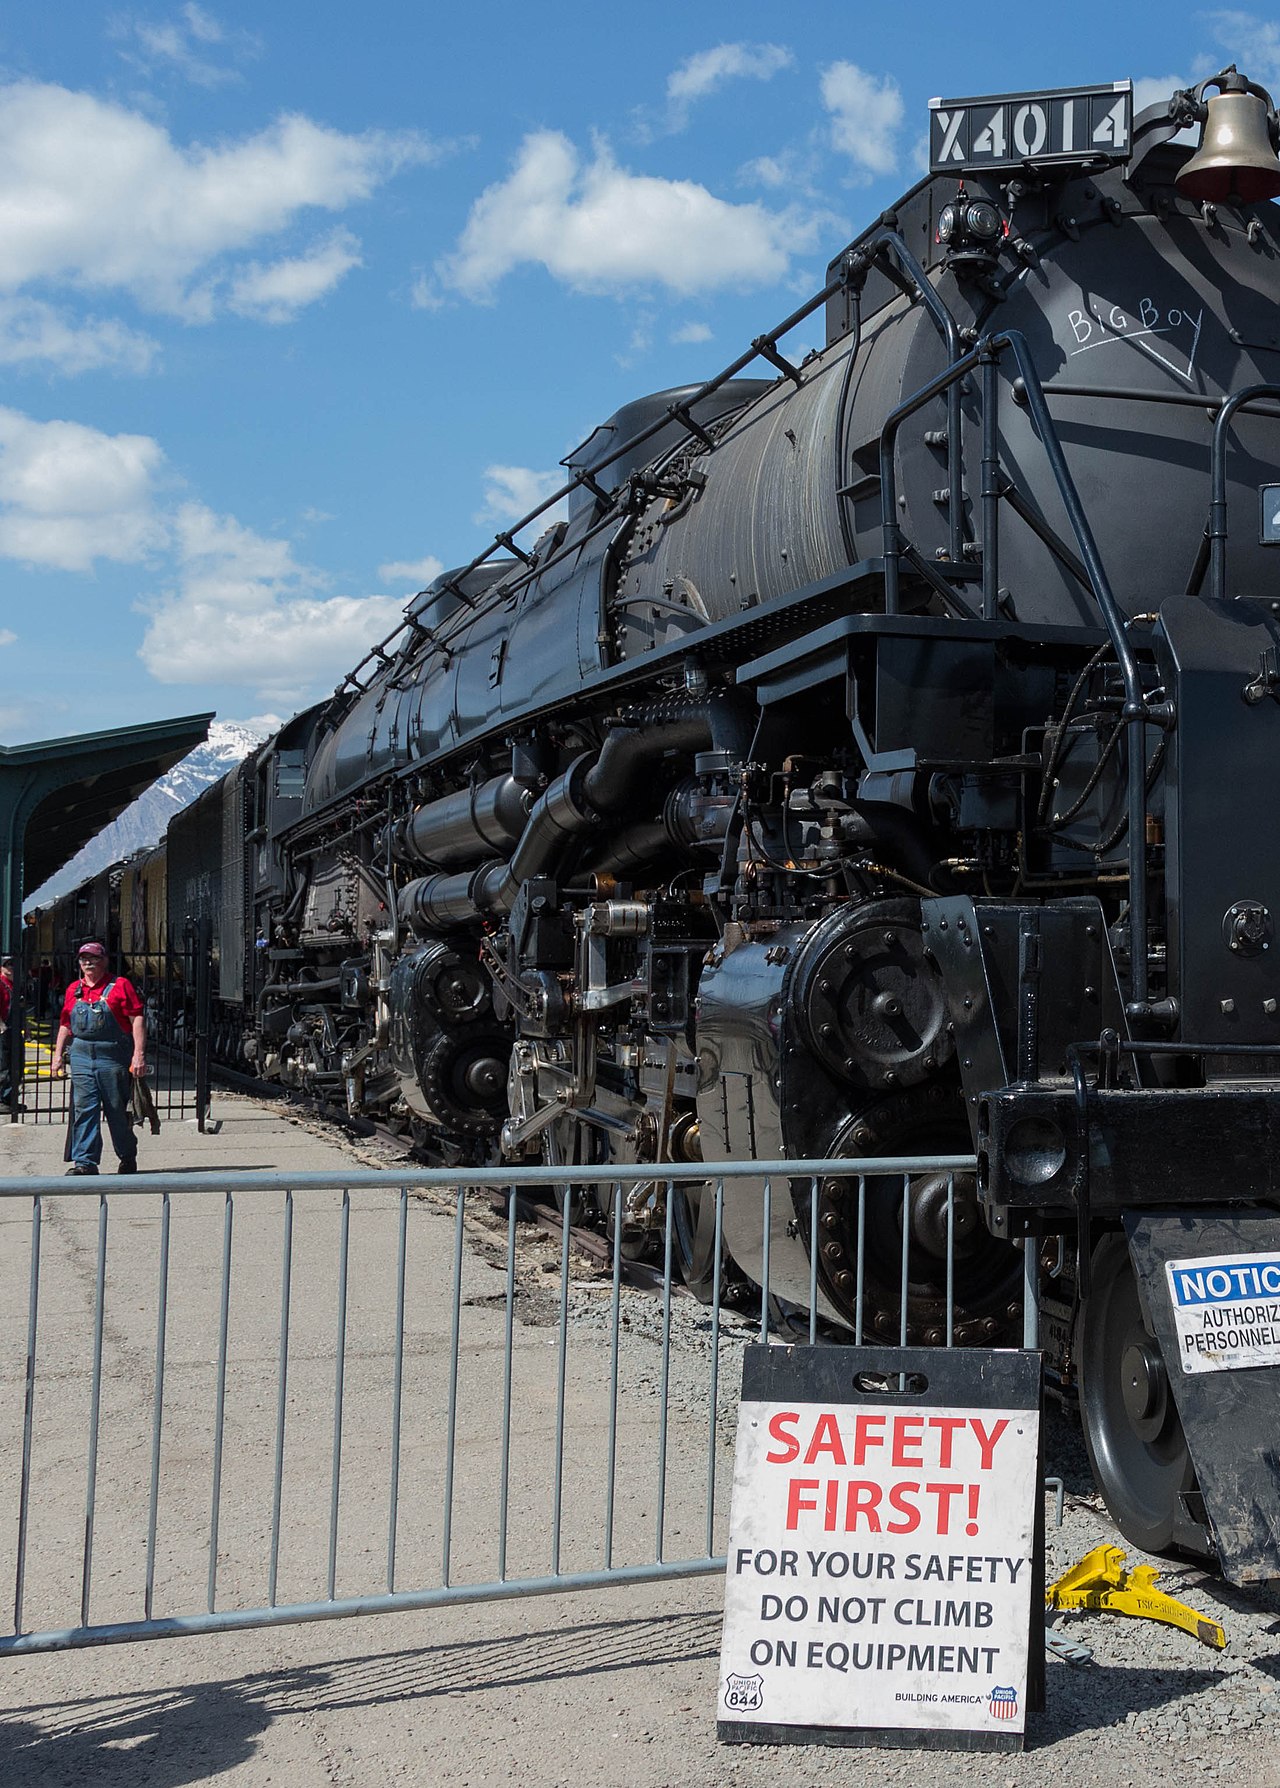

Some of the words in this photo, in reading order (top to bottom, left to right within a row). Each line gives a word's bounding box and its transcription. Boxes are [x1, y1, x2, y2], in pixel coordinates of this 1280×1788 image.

[936, 95, 1128, 162] X4014
[1184, 1326, 1280, 1353] PERSONNEL
[765, 1411, 1011, 1470] SAFETY
[785, 1478, 981, 1537] FIRST!
[735, 1549, 799, 1577] FOR
[806, 1551, 895, 1580] YOUR
[904, 1553, 1025, 1584] SAFETY
[761, 1594, 808, 1622] DO
[817, 1596, 886, 1624] NOT
[894, 1599, 994, 1629] CLIMB
[750, 1639, 797, 1667] ON
[806, 1641, 1000, 1673] EQUIPMENT
[729, 1692, 758, 1706] 844
[895, 1692, 938, 1702] BUILDING
